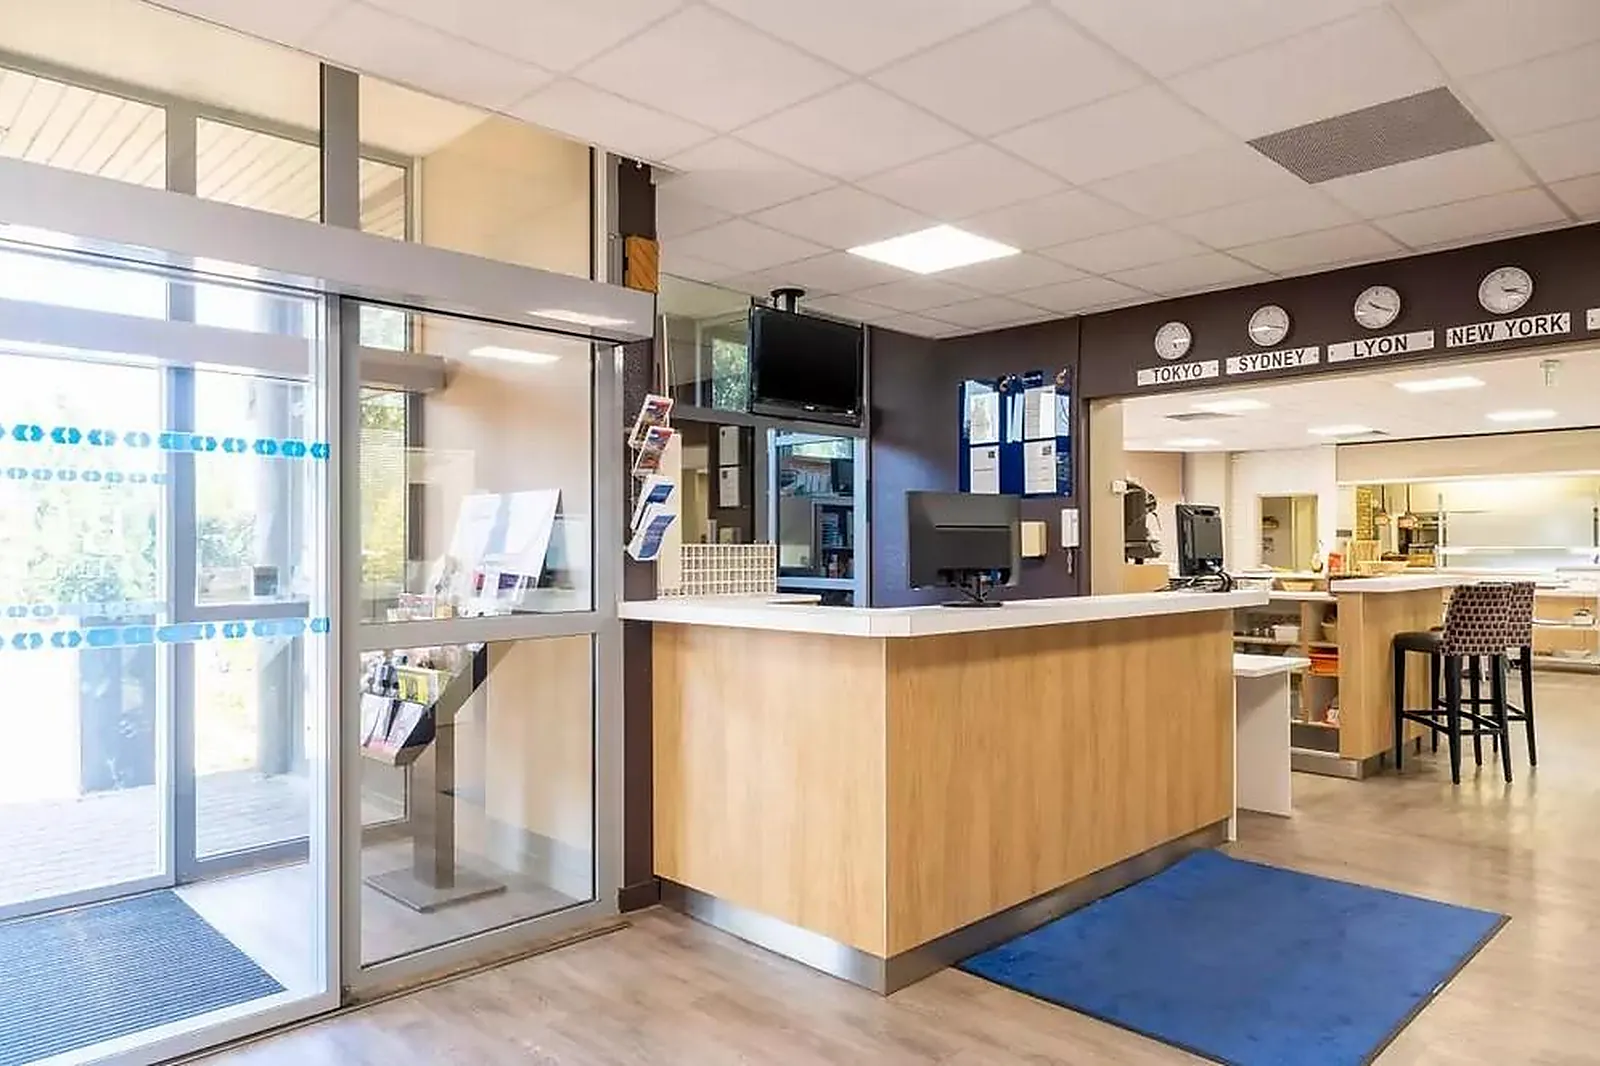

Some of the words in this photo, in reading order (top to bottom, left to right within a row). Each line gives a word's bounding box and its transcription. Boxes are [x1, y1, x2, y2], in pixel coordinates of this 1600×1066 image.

[1452, 325, 1494, 344] NEW
[1505, 314, 1563, 337] YORK
[1353, 336, 1408, 357] LYON
[1239, 350, 1305, 371] SYDNEY
[1154, 364, 1202, 382] TOKYO
